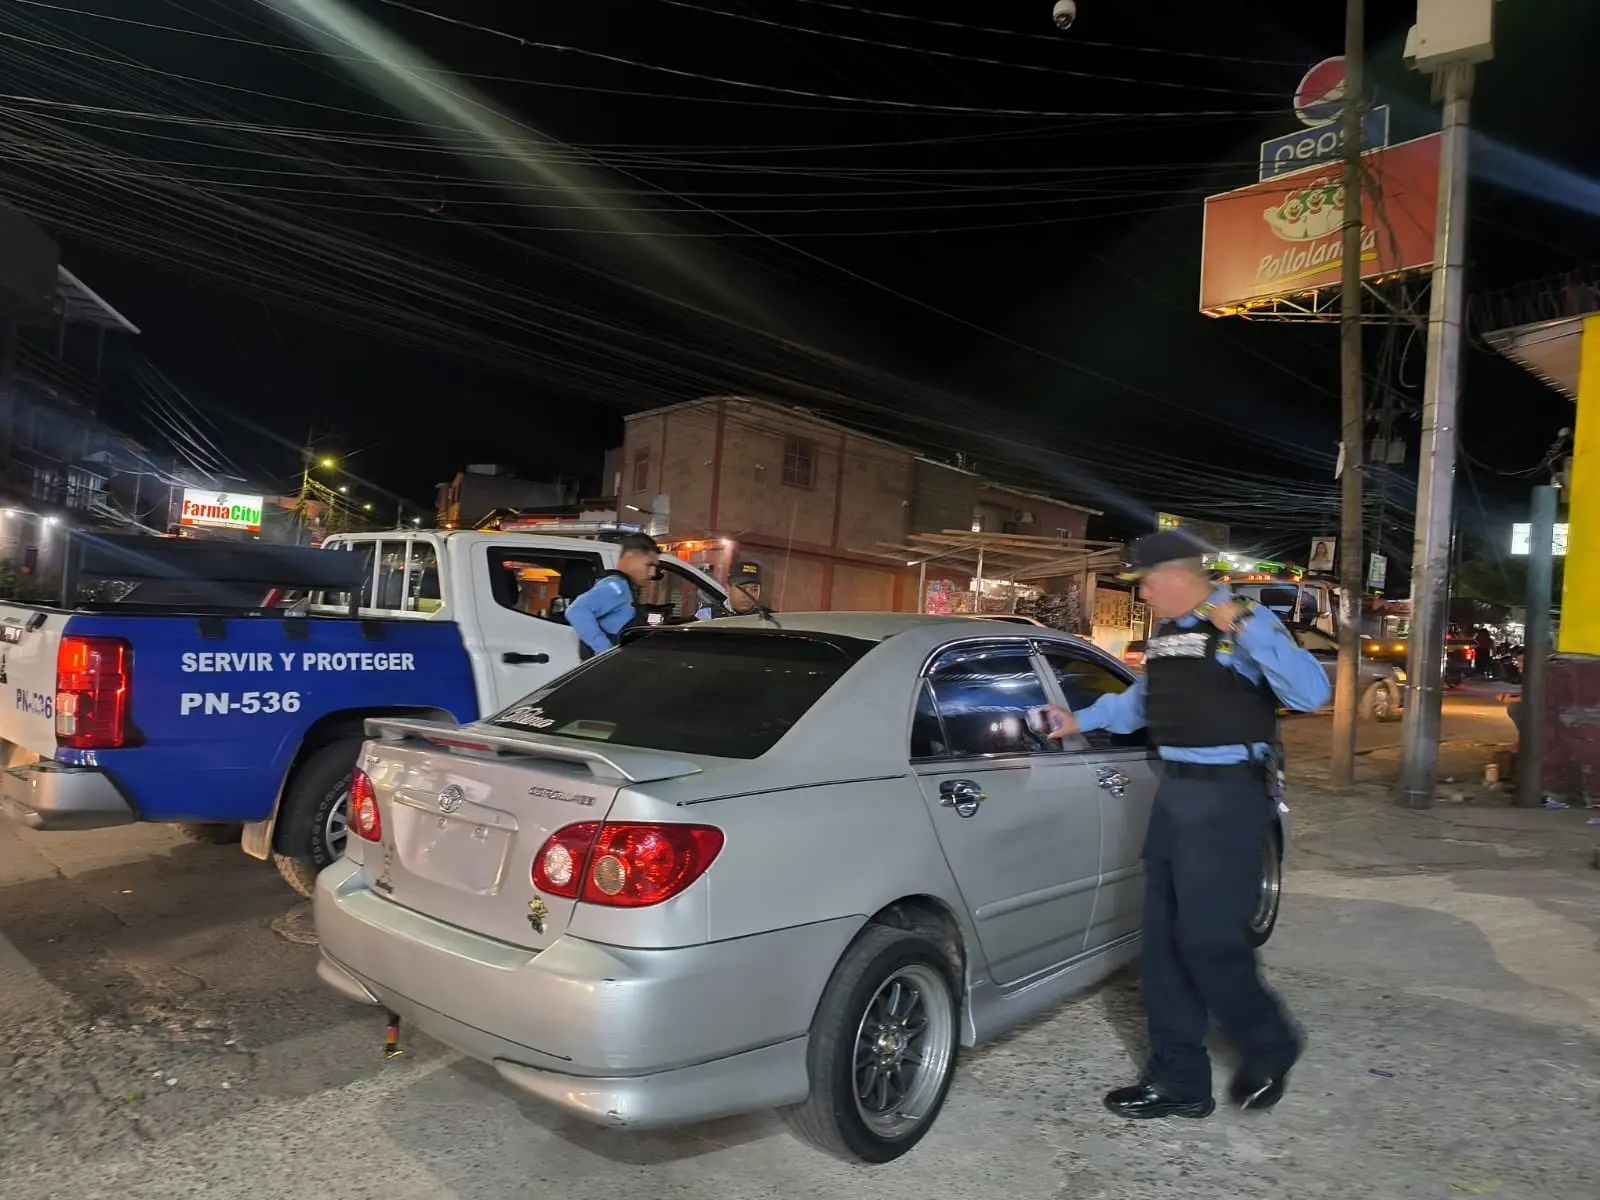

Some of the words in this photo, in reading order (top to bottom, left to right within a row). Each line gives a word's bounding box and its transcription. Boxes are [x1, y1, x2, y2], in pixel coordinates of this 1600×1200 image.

[1274, 118, 1363, 173] pep
[1256, 226, 1378, 281] Pollolana
[183, 500, 260, 524] FarmaCity
[181, 652, 274, 673] SERVIR
[280, 652, 296, 672] Y
[303, 652, 415, 671] PROTEGER
[180, 691, 301, 716] PN-536
